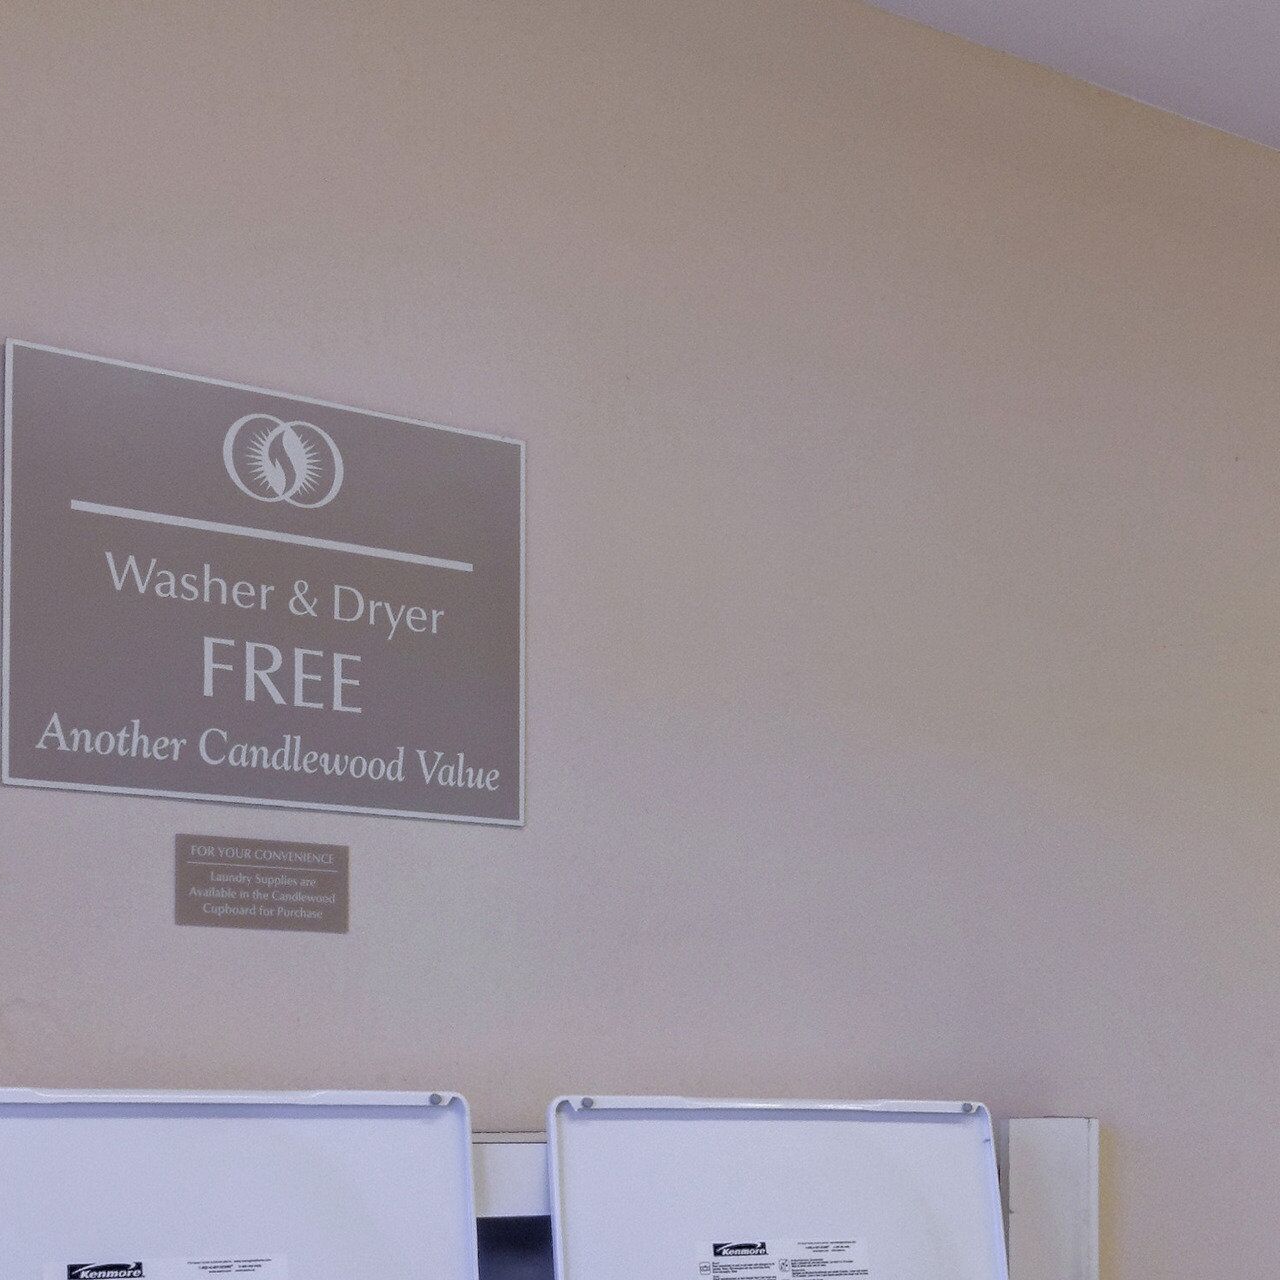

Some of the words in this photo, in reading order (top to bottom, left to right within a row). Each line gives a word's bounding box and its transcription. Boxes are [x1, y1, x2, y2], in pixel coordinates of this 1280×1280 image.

[105, 550, 274, 611] Washer
[288, 580, 318, 617] &
[333, 585, 445, 640] Dryer
[202, 636, 362, 714] FREE
[35, 712, 186, 762] Another
[199, 727, 405, 783] Candlewood
[416, 749, 500, 792] Value
[191, 845, 215, 856] FOR
[217, 847, 252, 860] YOUR
[254, 849, 334, 865] CONVENIENCE
[210, 871, 252, 884] Laundry
[256, 873, 297, 887] Supplies
[300, 878, 317, 888] are
[189, 887, 237, 899] Available
[239, 889, 250, 899] in
[252, 889, 269, 900] the
[272, 891, 336, 904] Candlewood
[203, 903, 256, 917] Cupboard
[259, 904, 273, 917] for
[277, 907, 323, 920] Purchase
